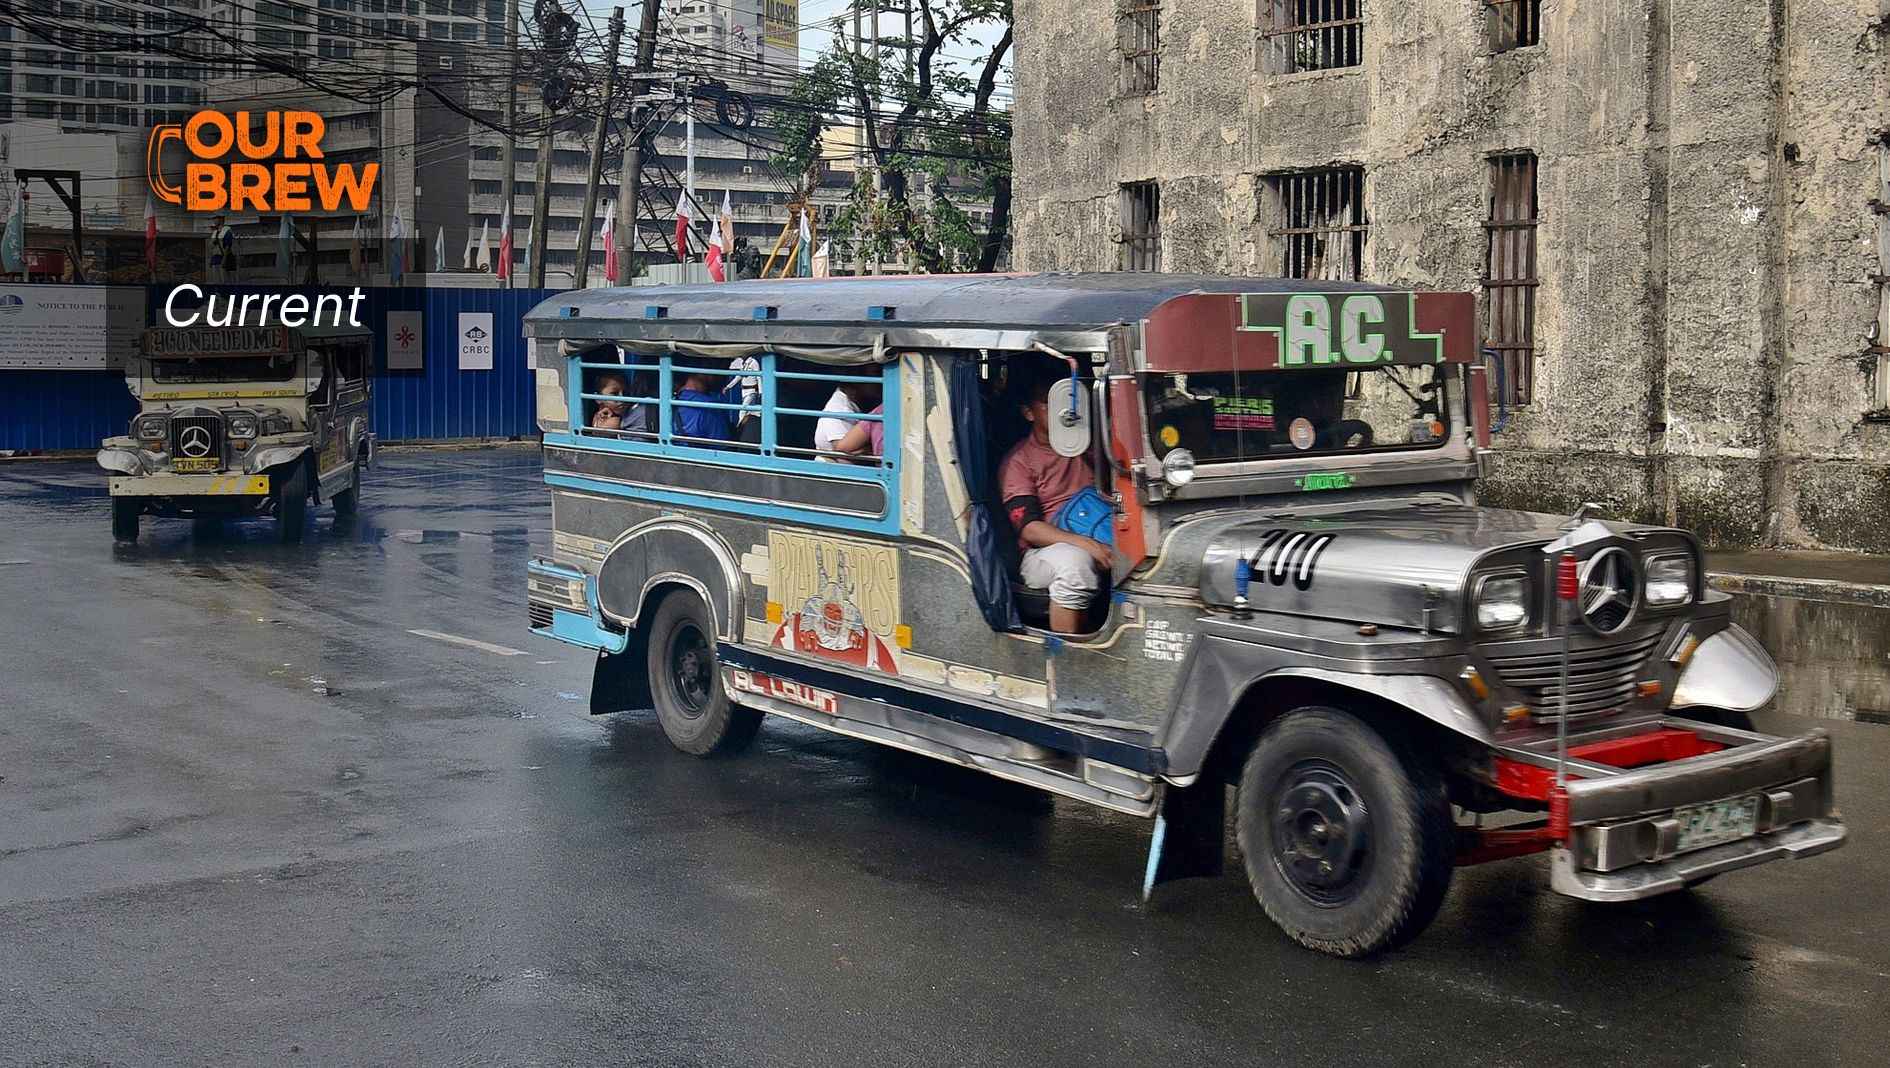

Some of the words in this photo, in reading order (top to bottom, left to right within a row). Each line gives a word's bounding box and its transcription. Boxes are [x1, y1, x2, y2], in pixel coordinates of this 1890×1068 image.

[462, 345, 490, 354] CRBC
[1286, 295, 1393, 364] A.C.
[1249, 529, 1338, 591] 200
